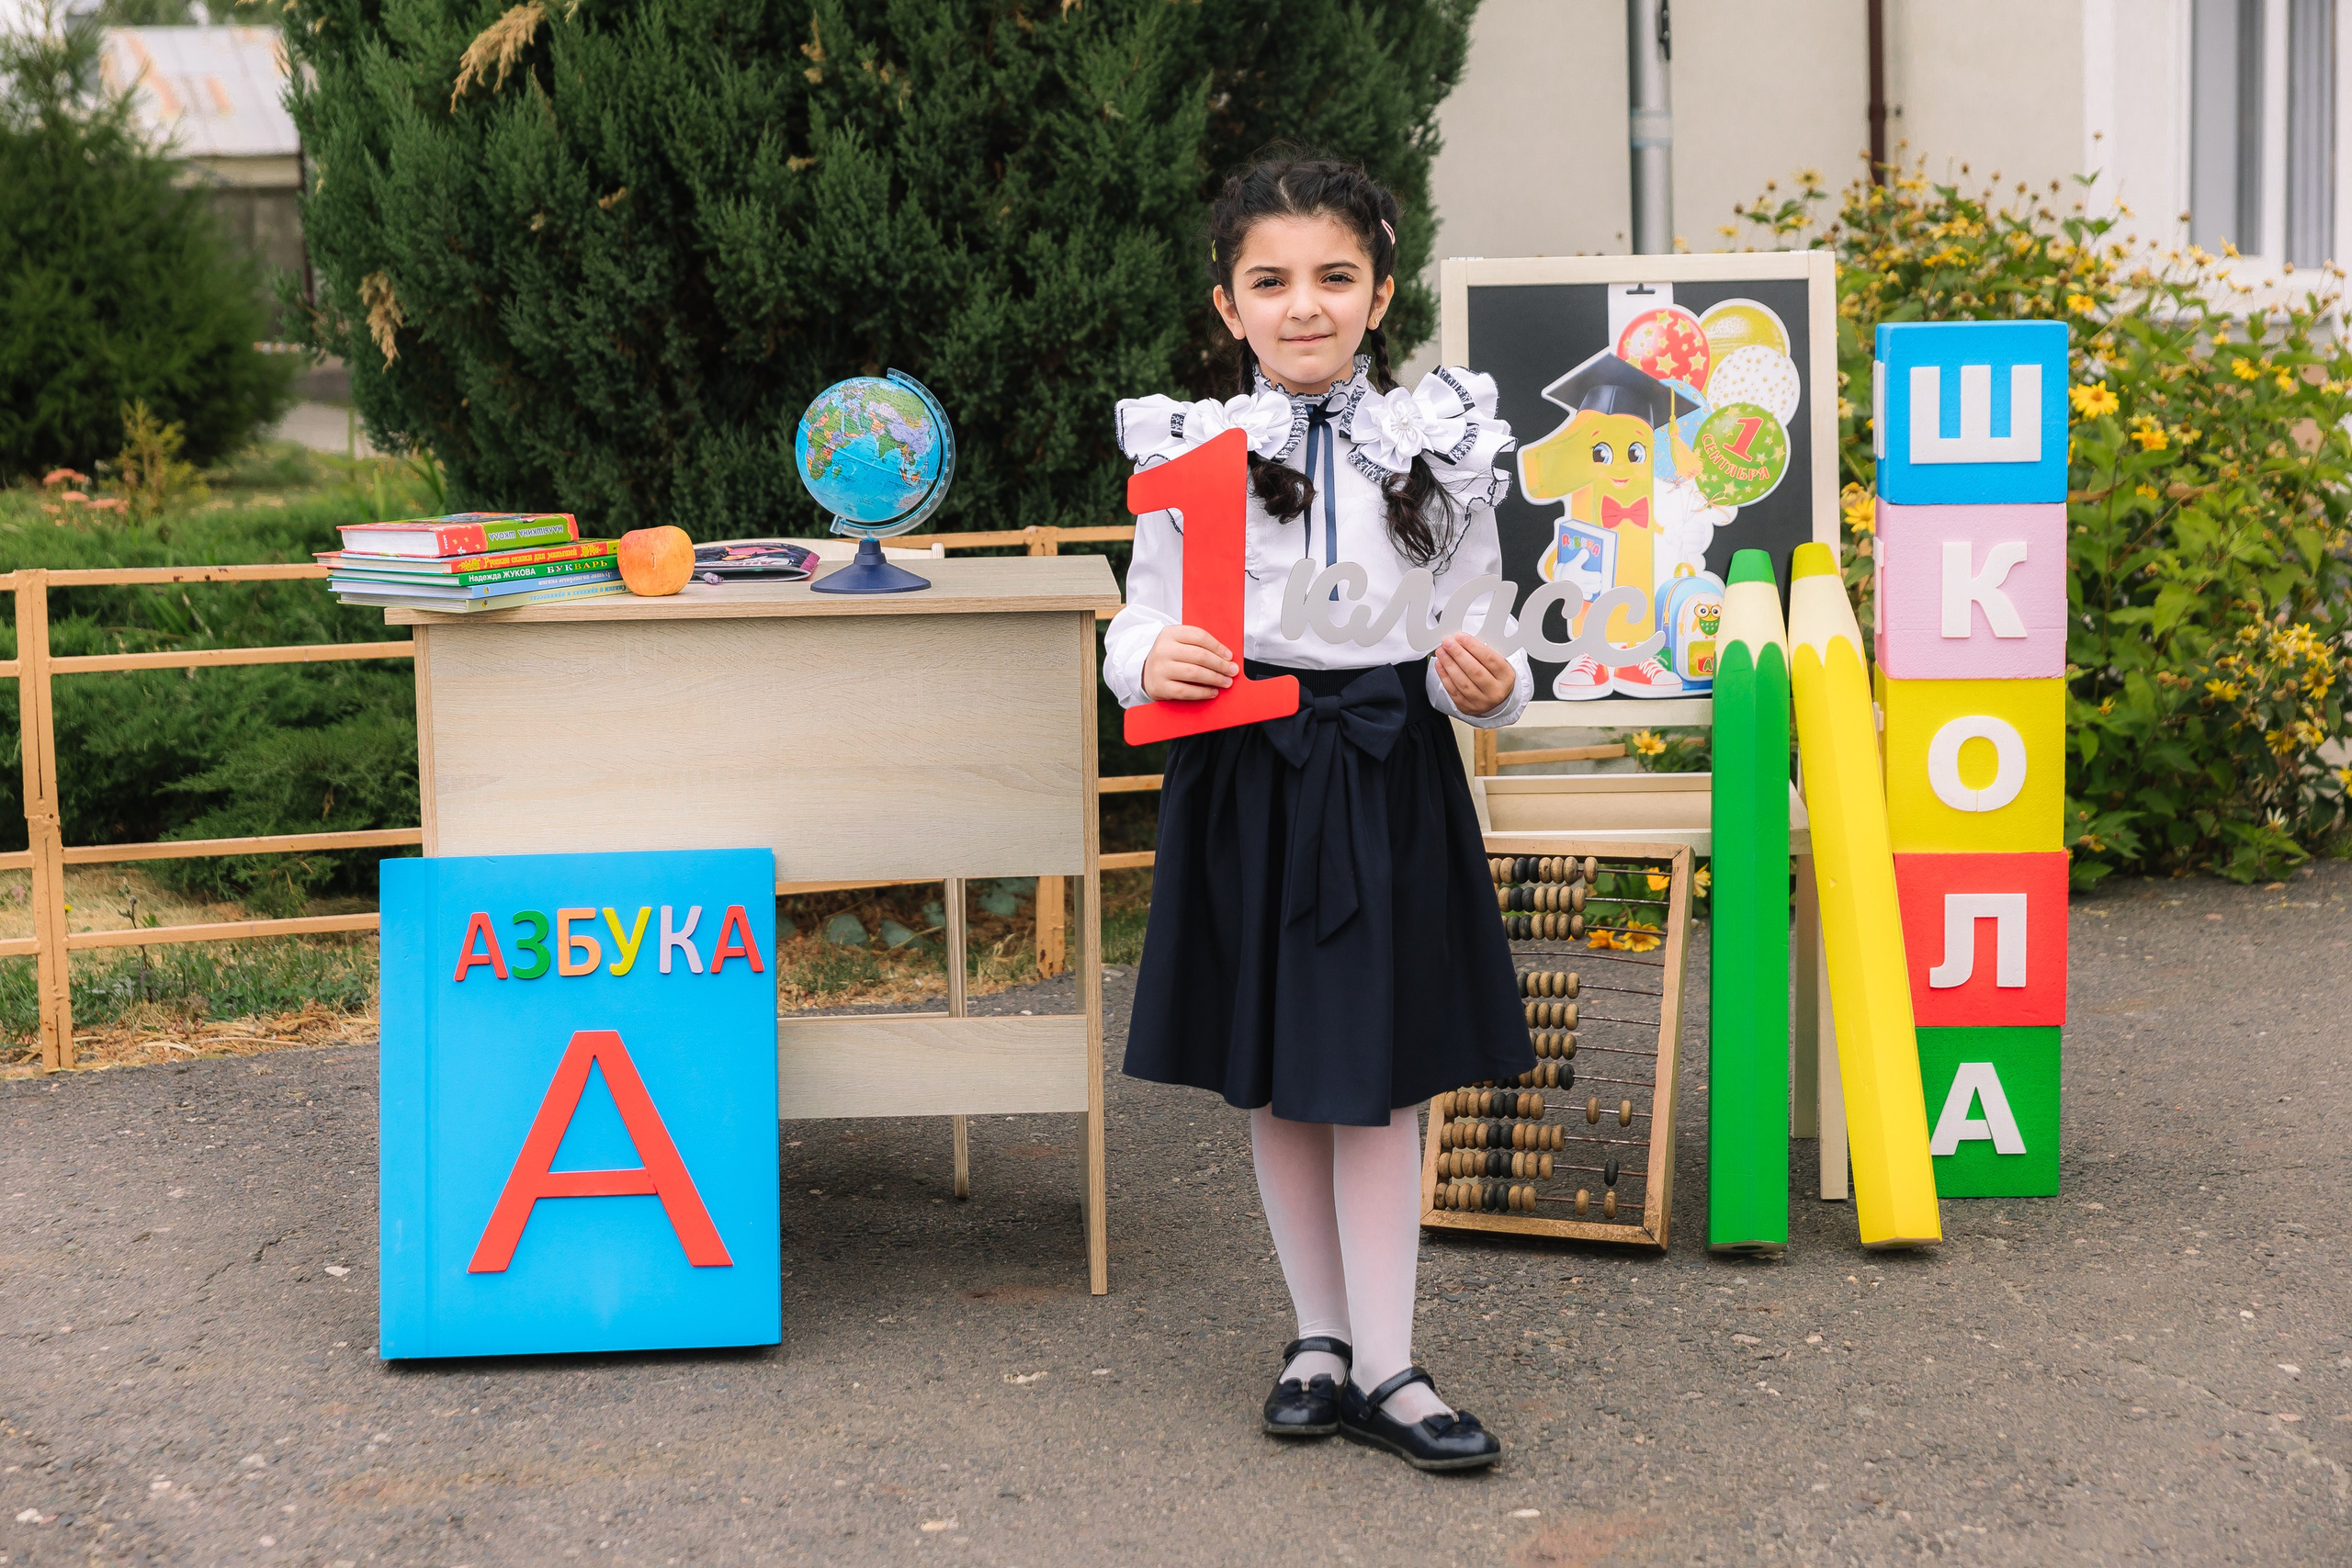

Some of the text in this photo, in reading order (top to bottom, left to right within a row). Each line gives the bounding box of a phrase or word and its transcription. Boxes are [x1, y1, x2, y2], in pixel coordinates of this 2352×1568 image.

[1702, 434, 1770, 481] СЕНТЯБРЯ
[1723, 416, 1764, 462] 1
[489, 525, 564, 542] МАЛЫШКИНА ШКОЛА
[1562, 534, 1600, 557] АЗБУКА
[469, 559, 608, 582] Надежда ЖУКОВА БУКВАРЬ
[483, 547, 577, 568] Русские сказки для малышей
[605, 584, 627, 592] Сказки
[1123, 427, 1300, 746] 1
[1280, 558, 1667, 668] класс
[1909, 364, 2043, 1156] ШКОЛА
[454, 905, 764, 982] АЗБУКА
[467, 1030, 734, 1273] А
